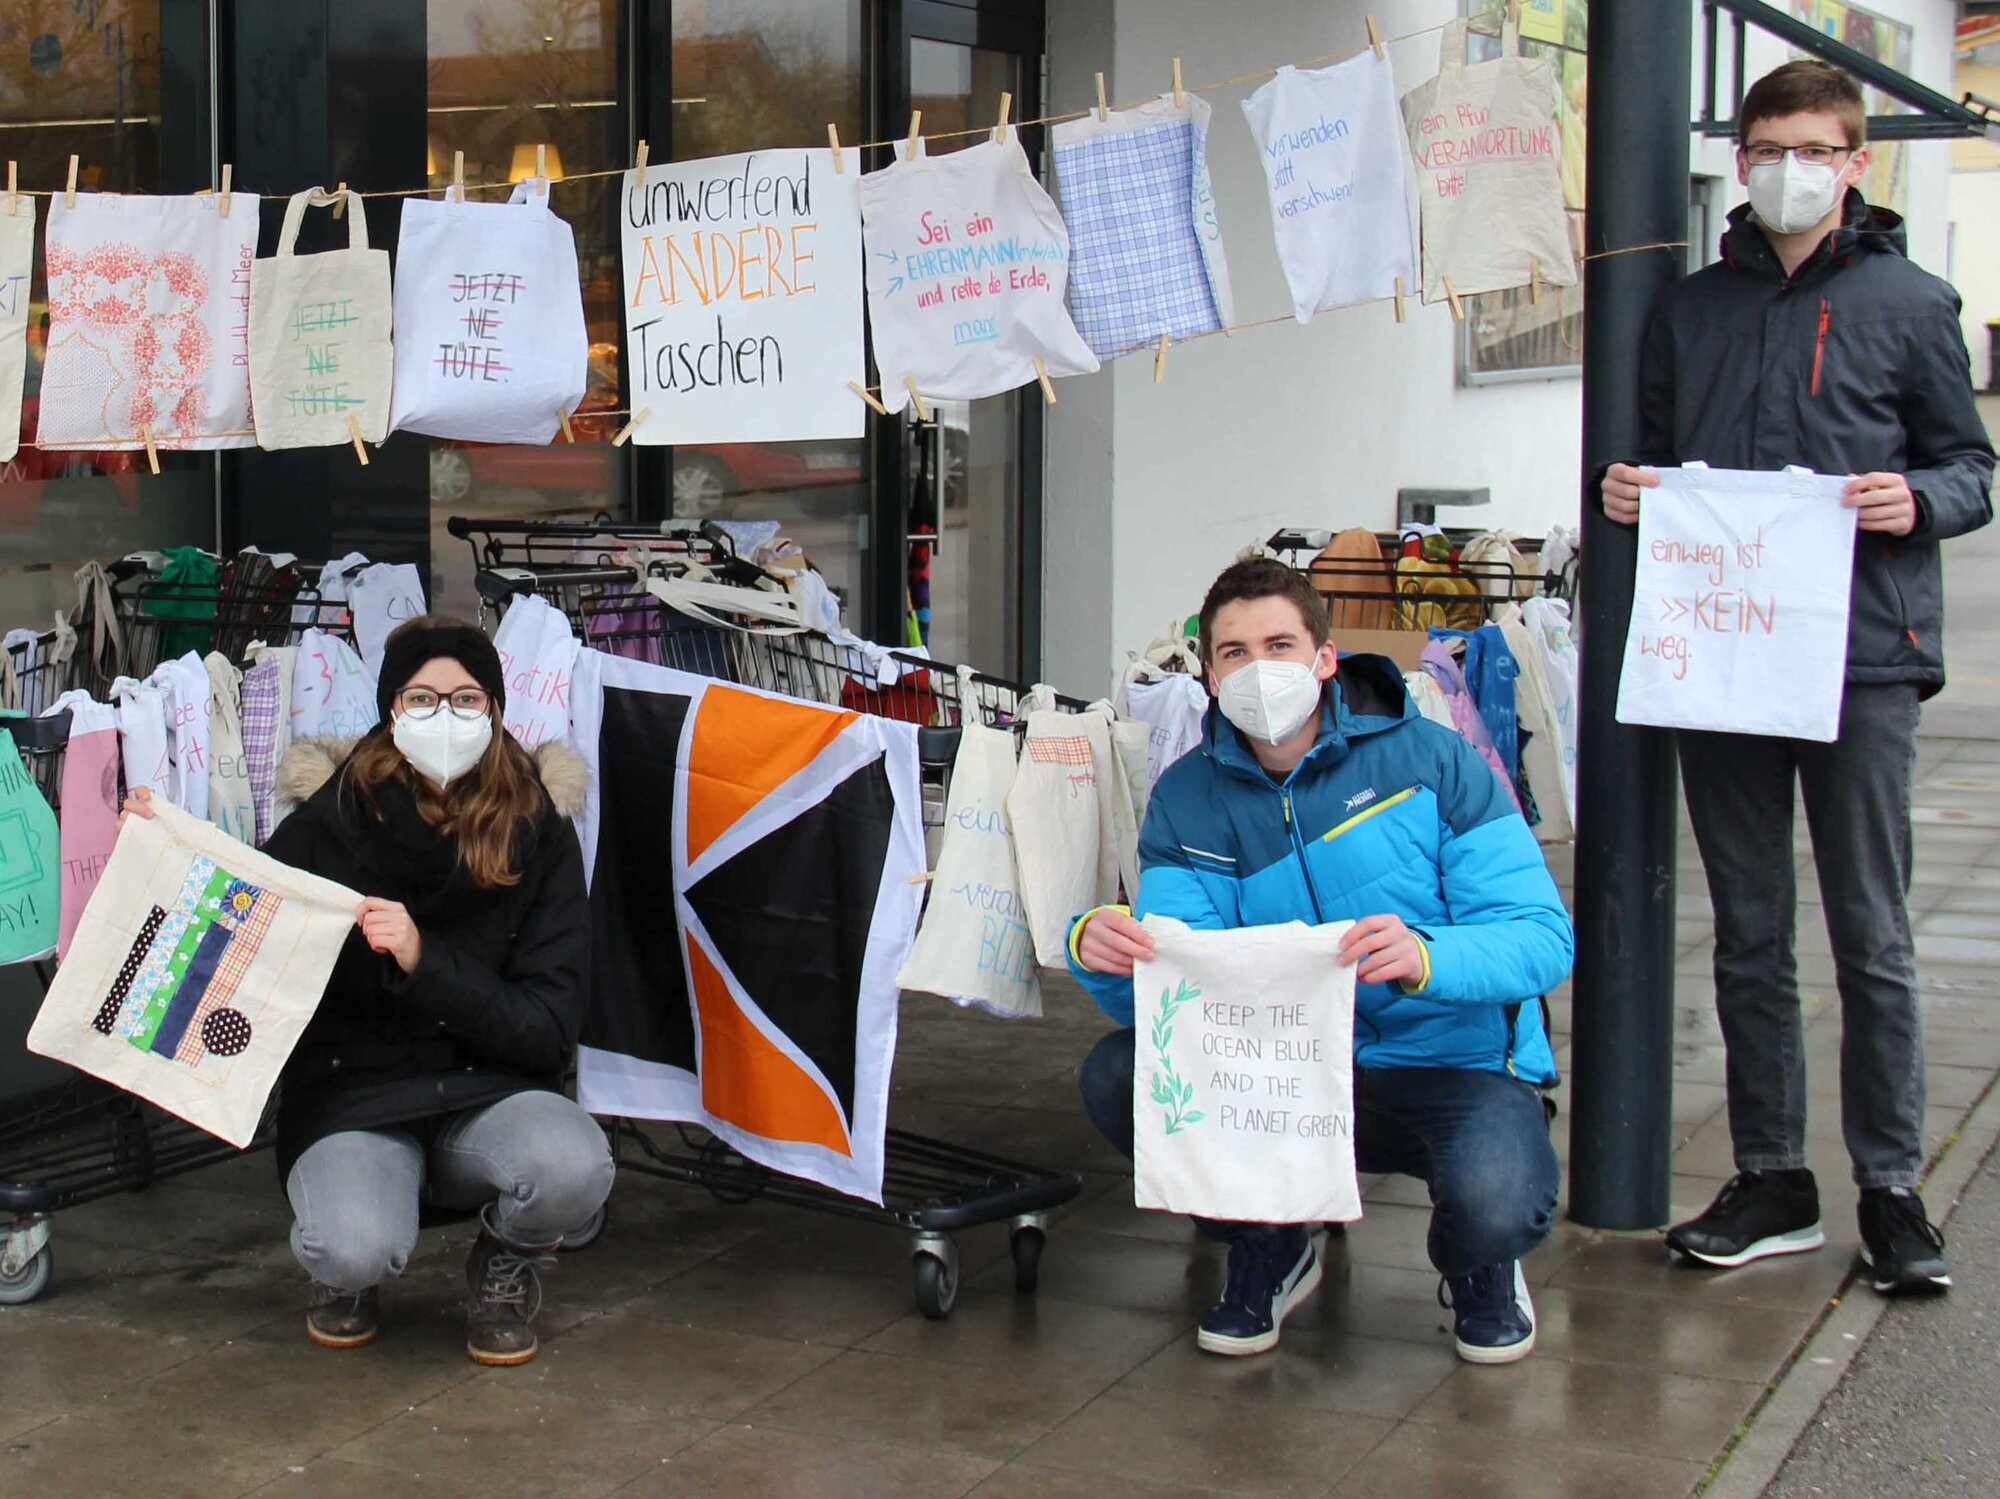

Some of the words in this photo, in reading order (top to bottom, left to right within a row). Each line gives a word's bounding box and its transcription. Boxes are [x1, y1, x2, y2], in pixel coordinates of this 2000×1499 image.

[917, 210, 951, 246] Sei
[965, 211, 994, 237] ein
[631, 222, 818, 308] ANDERE
[452, 273, 523, 305] JETZT
[917, 282, 944, 309] und
[292, 298, 353, 342] JETZT
[467, 307, 500, 340] NE
[627, 314, 783, 393] Taschen
[287, 382, 349, 417] TÜTE
[1650, 537, 1725, 587] einweg
[1736, 525, 1765, 569] ist
[1640, 635, 1692, 681] weg.
[1202, 1001, 1256, 1027] KEEP
[1265, 1003, 1309, 1029] THE
[1201, 1032, 1263, 1061] OCEAN
[1274, 1038, 1324, 1063] BLUE
[1209, 1070, 1254, 1094] AND
[1263, 1074, 1303, 1099] THE
[1219, 1103, 1292, 1135] PLANET
[1296, 1113, 1348, 1139] GREEN
